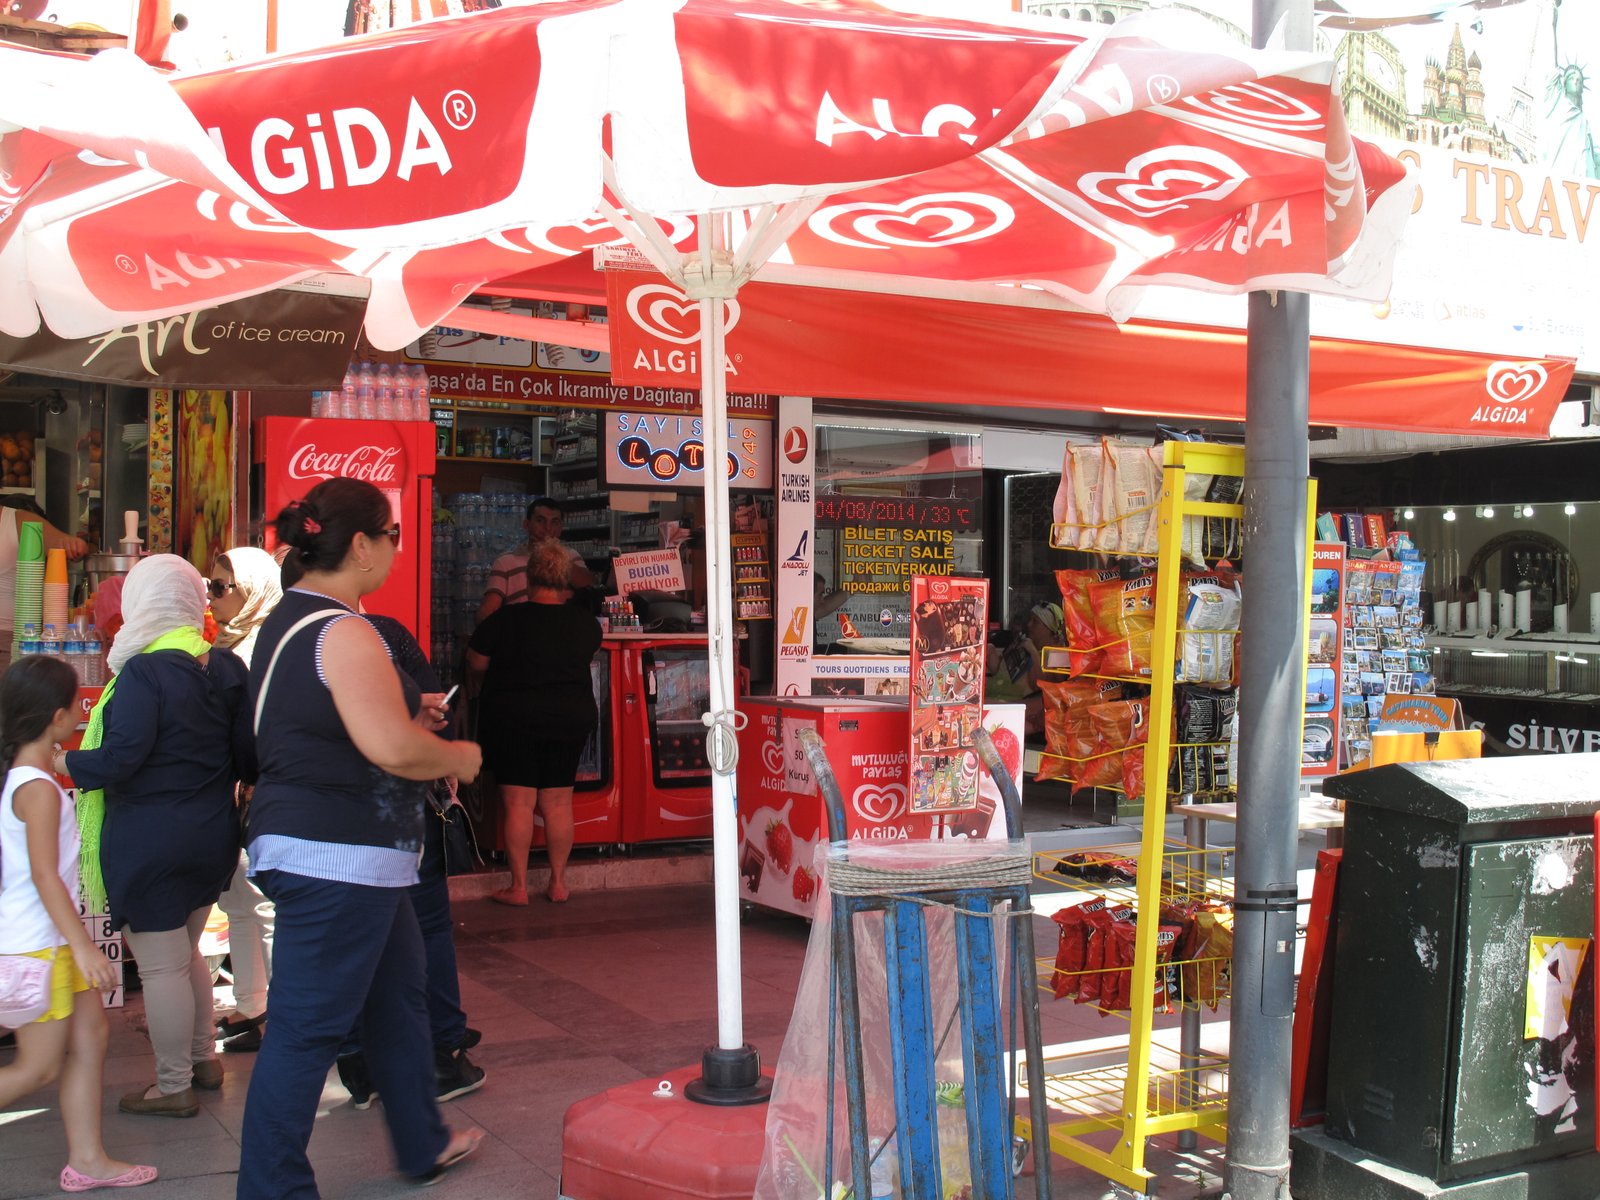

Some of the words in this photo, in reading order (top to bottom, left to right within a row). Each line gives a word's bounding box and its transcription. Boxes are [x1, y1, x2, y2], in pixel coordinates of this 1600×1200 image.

[211, 322, 235, 339] of
[238, 321, 271, 341] ice
[277, 327, 345, 344] cream
[492, 375, 514, 393] En
[520, 377, 553, 398] Çok
[558, 376, 629, 404] İkramiye
[633, 386, 694, 407] Dağıtan
[618, 413, 737, 439] SAYISL
[742, 427, 759, 479] 6/49
[288, 443, 402, 481] Coca-Cola
[781, 473, 810, 488] TURKISH
[781, 489, 810, 503] AIRLINES
[931, 506, 951, 522] 33
[902, 528, 954, 546] SATIŞ
[844, 544, 906, 559] TICKET
[910, 546, 954, 559] SALE
[1312, 550, 1341, 561] OUREN
[640, 555, 650, 564] ON
[780, 561, 810, 570] ANADOLU
[628, 563, 670, 580] BUGÜN
[797, 569, 809, 577] JET
[843, 561, 955, 577] TICKETVERKAUF
[842, 580, 899, 595] продажи
[780, 645, 809, 656] PEGASUS
[815, 665, 842, 674] TOURS
[843, 665, 890, 674] QUOTIDIENS
[893, 665, 911, 675] ЕЖЕД
[794, 750, 804, 761] 50
[787, 768, 810, 784] Kuruş
[102, 919, 114, 938] 8
